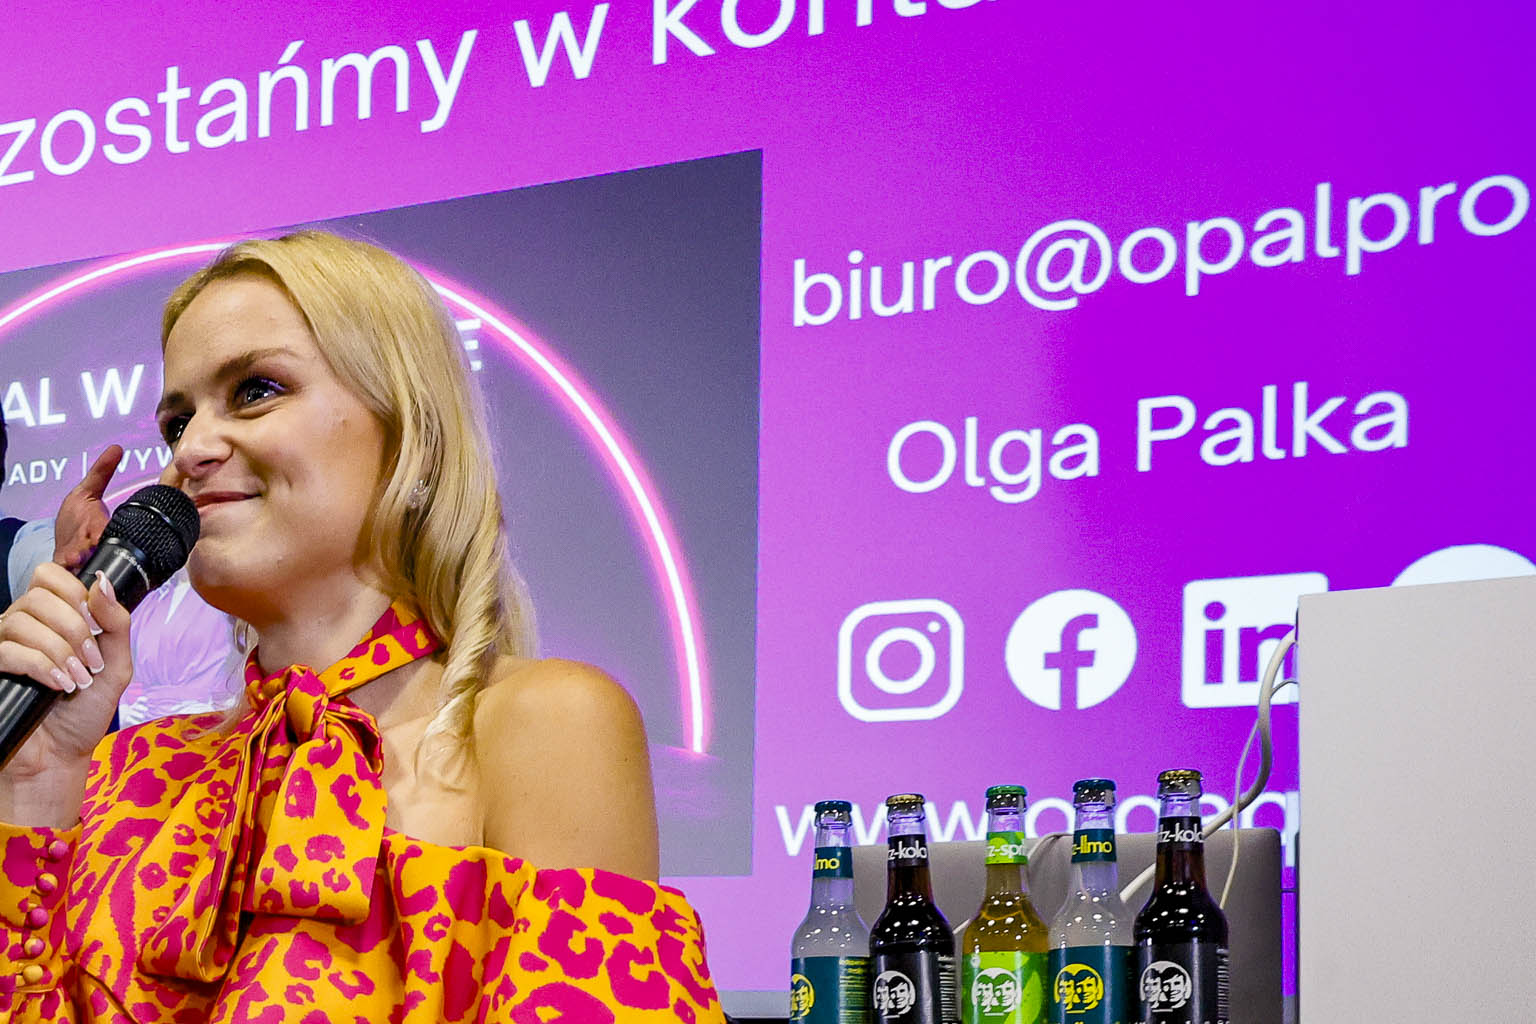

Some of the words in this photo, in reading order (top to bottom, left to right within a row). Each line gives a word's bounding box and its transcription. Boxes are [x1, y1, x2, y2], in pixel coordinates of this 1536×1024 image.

[515, 3, 610, 88] w
[792, 174, 1531, 327] biuro@opalpro
[4, 377, 66, 427] AL
[887, 416, 1100, 503] Olga
[1135, 382, 1409, 472] Palka
[8, 457, 68, 487] ADY
